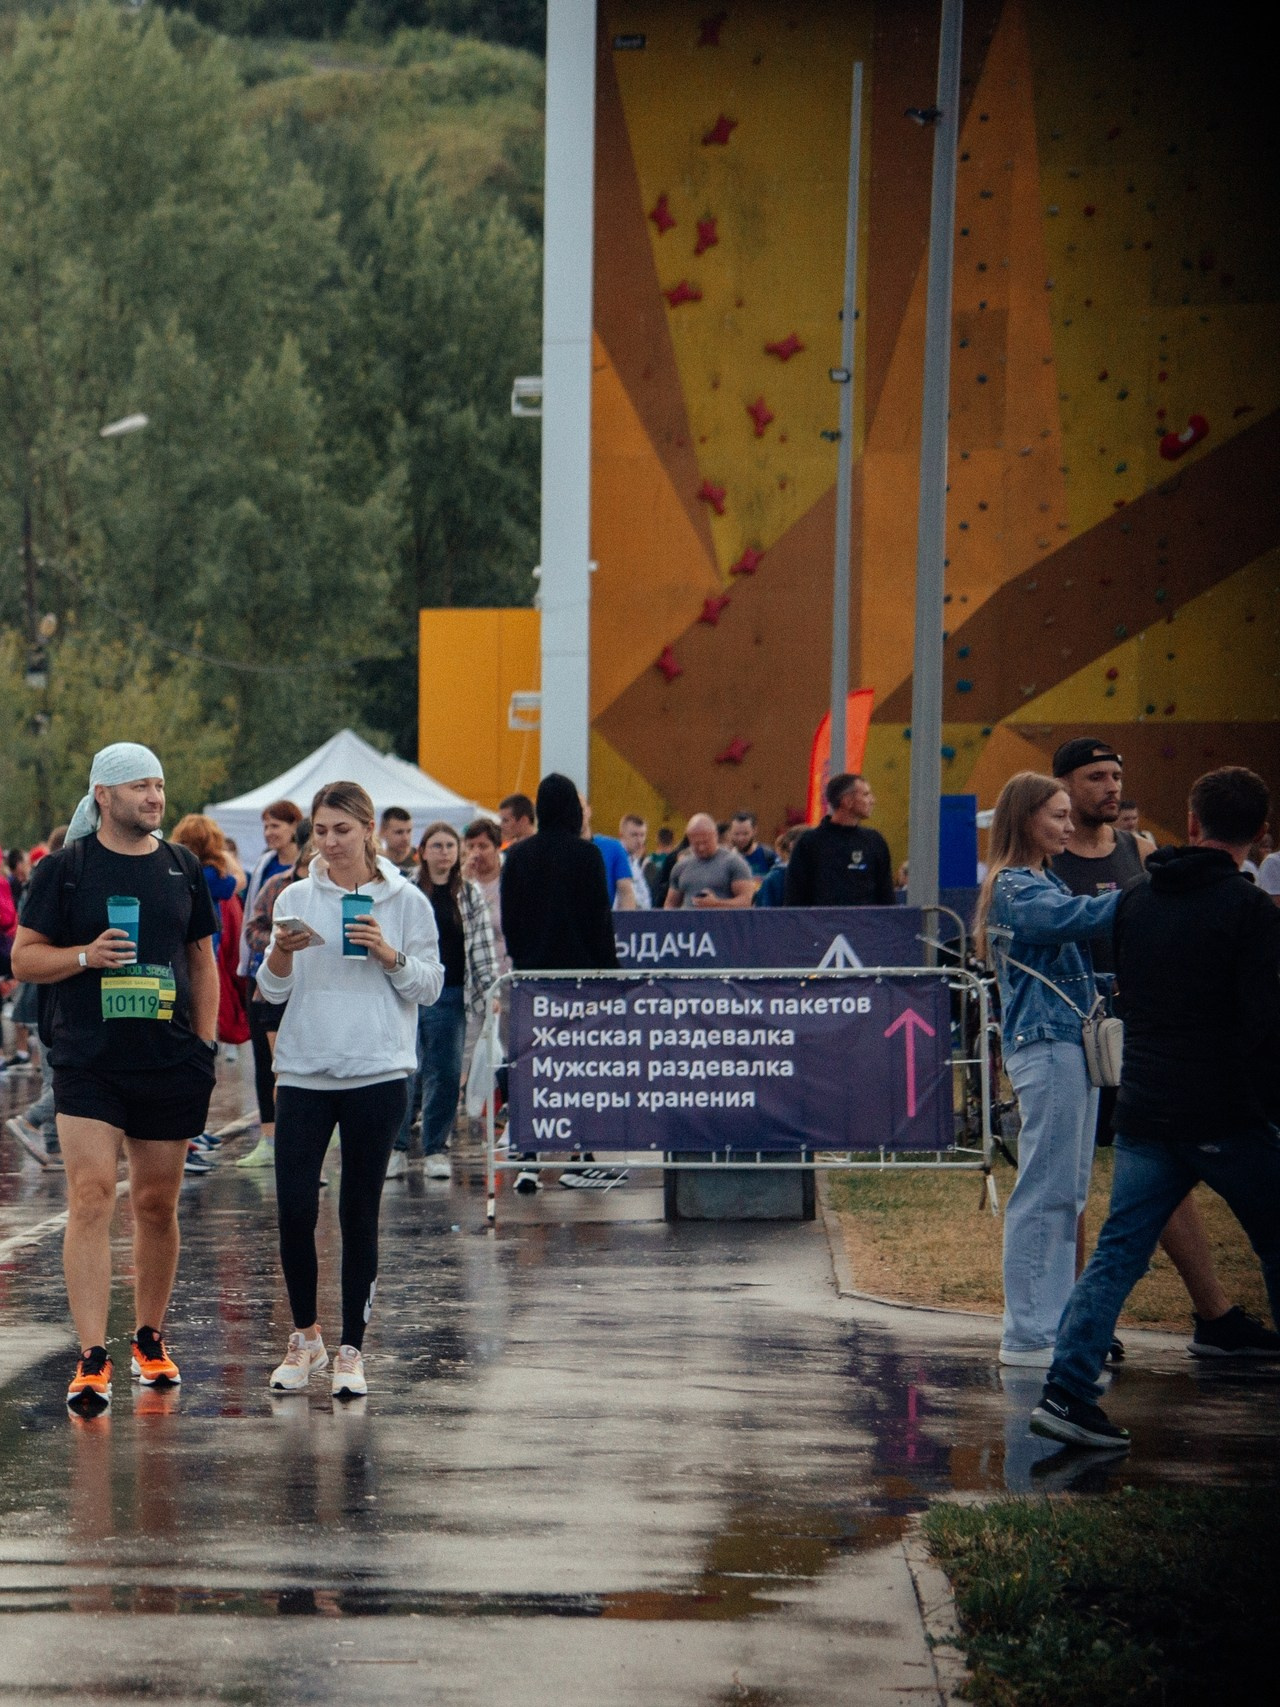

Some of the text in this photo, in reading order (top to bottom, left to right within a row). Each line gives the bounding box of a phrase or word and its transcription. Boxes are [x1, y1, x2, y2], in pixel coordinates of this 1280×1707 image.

[614, 932, 716, 962] ЫДАЧА
[106, 994, 158, 1013] 10119
[533, 995, 871, 1020] Выдача стартовых пакетов
[531, 1026, 795, 1051] Женская раздевалка
[532, 1056, 794, 1082] Мужская раздевалка
[532, 1087, 755, 1113] Камеры хранения
[531, 1117, 572, 1139] WC
